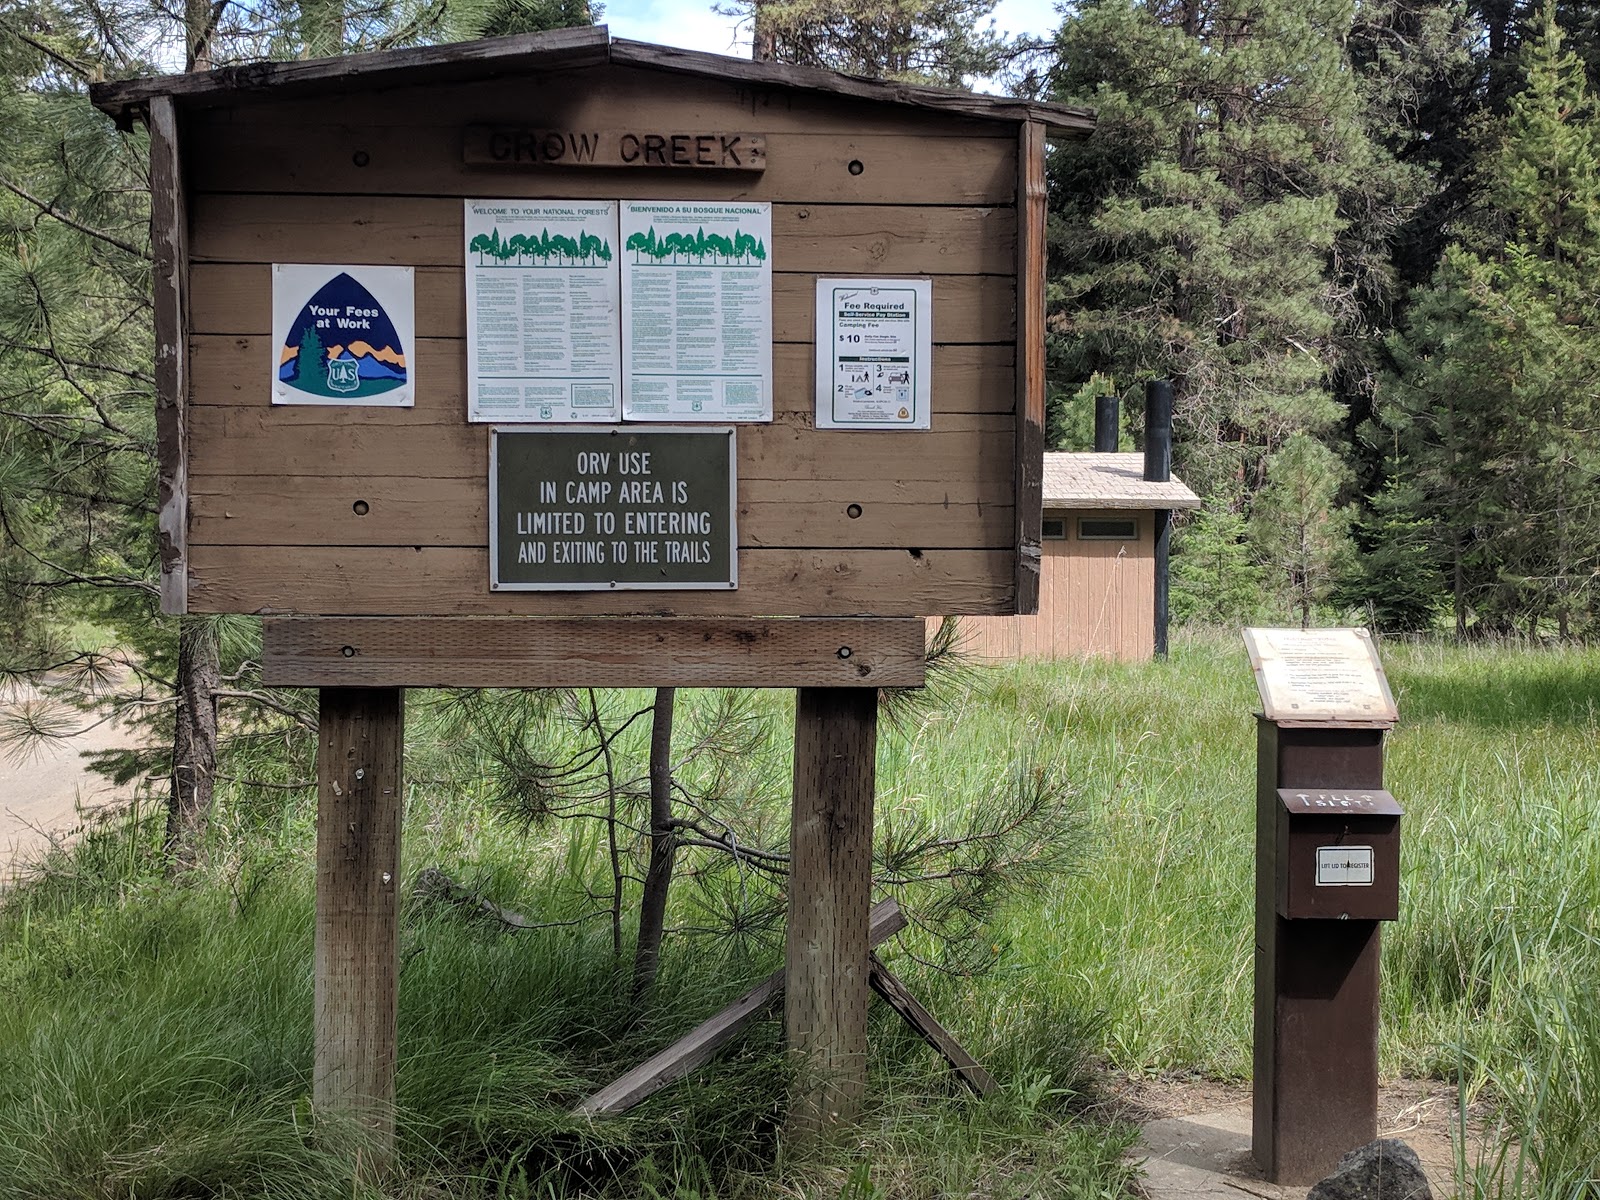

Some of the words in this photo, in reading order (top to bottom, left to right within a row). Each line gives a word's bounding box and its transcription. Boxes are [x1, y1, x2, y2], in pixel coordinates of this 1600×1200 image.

[489, 133, 600, 163] CROW
[620, 134, 742, 166] CREEK
[543, 208, 575, 216] NATIONAL
[630, 206, 674, 214] BIENVENIDO
[309, 305, 340, 316] Your
[346, 306, 379, 317] Fees
[844, 302, 861, 310] Fee
[863, 302, 905, 311] Required
[316, 319, 331, 328] at
[337, 318, 371, 329] Work
[839, 322, 867, 330] Camping
[847, 334, 860, 343] 10
[839, 364, 844, 372] 1
[876, 364, 882, 372] 3
[837, 384, 844, 393] 2
[875, 384, 882, 392] 4
[577, 452, 610, 475] ORV
[619, 452, 652, 475] USE
[540, 481, 557, 504] IN
[565, 481, 612, 504] CAMP
[619, 481, 664, 504] AREA
[672, 481, 688, 504] IS
[517, 512, 585, 535] LIMITED
[594, 512, 615, 535] TO
[625, 512, 711, 535] ENTERING
[518, 542, 546, 564] AND
[553, 541, 605, 564] EXITING
[611, 541, 627, 564] TO
[634, 541, 659, 564] THE
[665, 541, 711, 564] TRAILS
